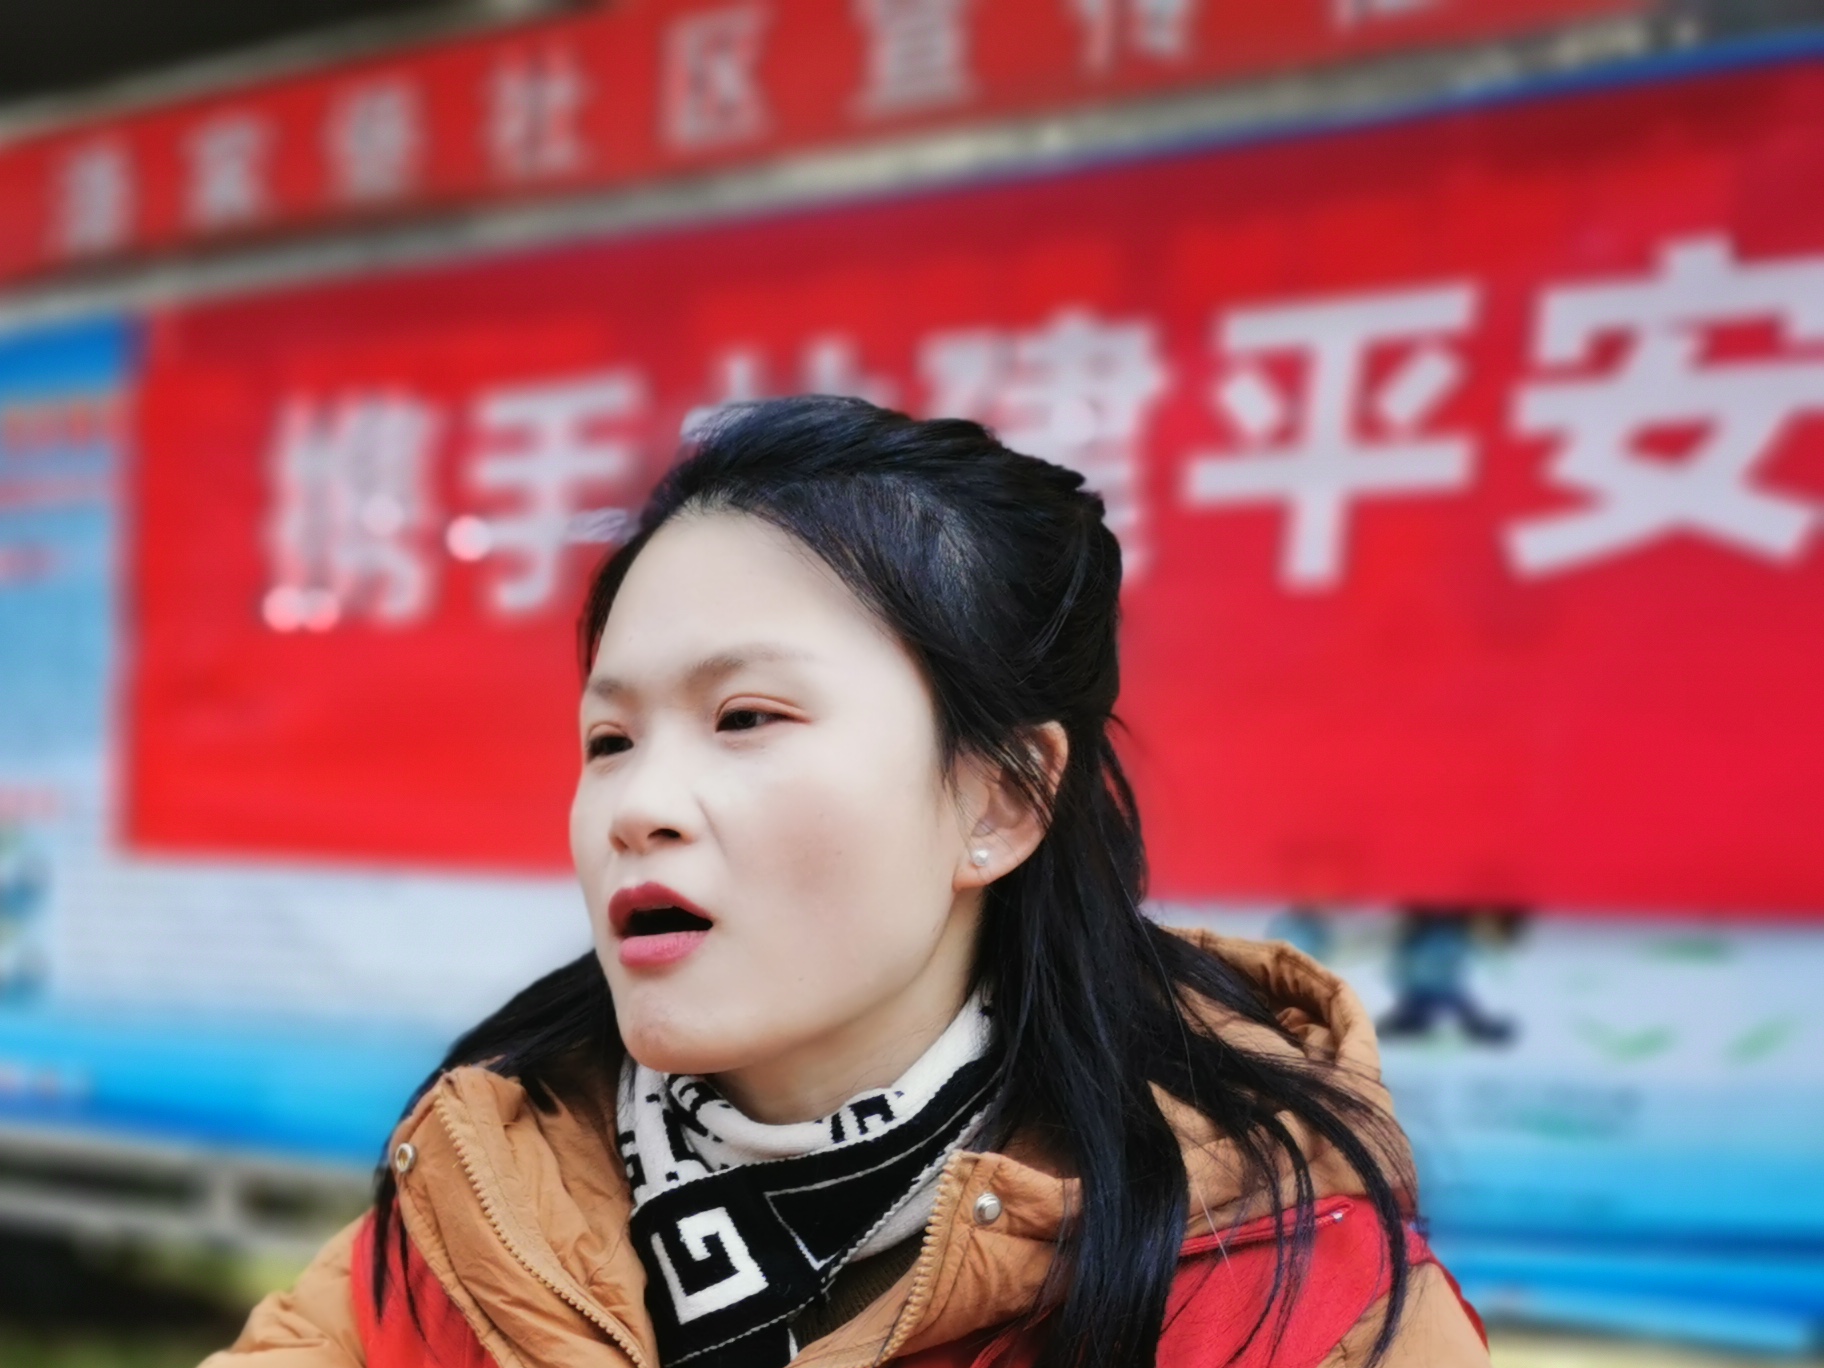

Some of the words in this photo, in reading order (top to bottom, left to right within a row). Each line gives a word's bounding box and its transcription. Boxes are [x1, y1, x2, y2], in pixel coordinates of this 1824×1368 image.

[268, 235, 1824, 625] 携手建平安
